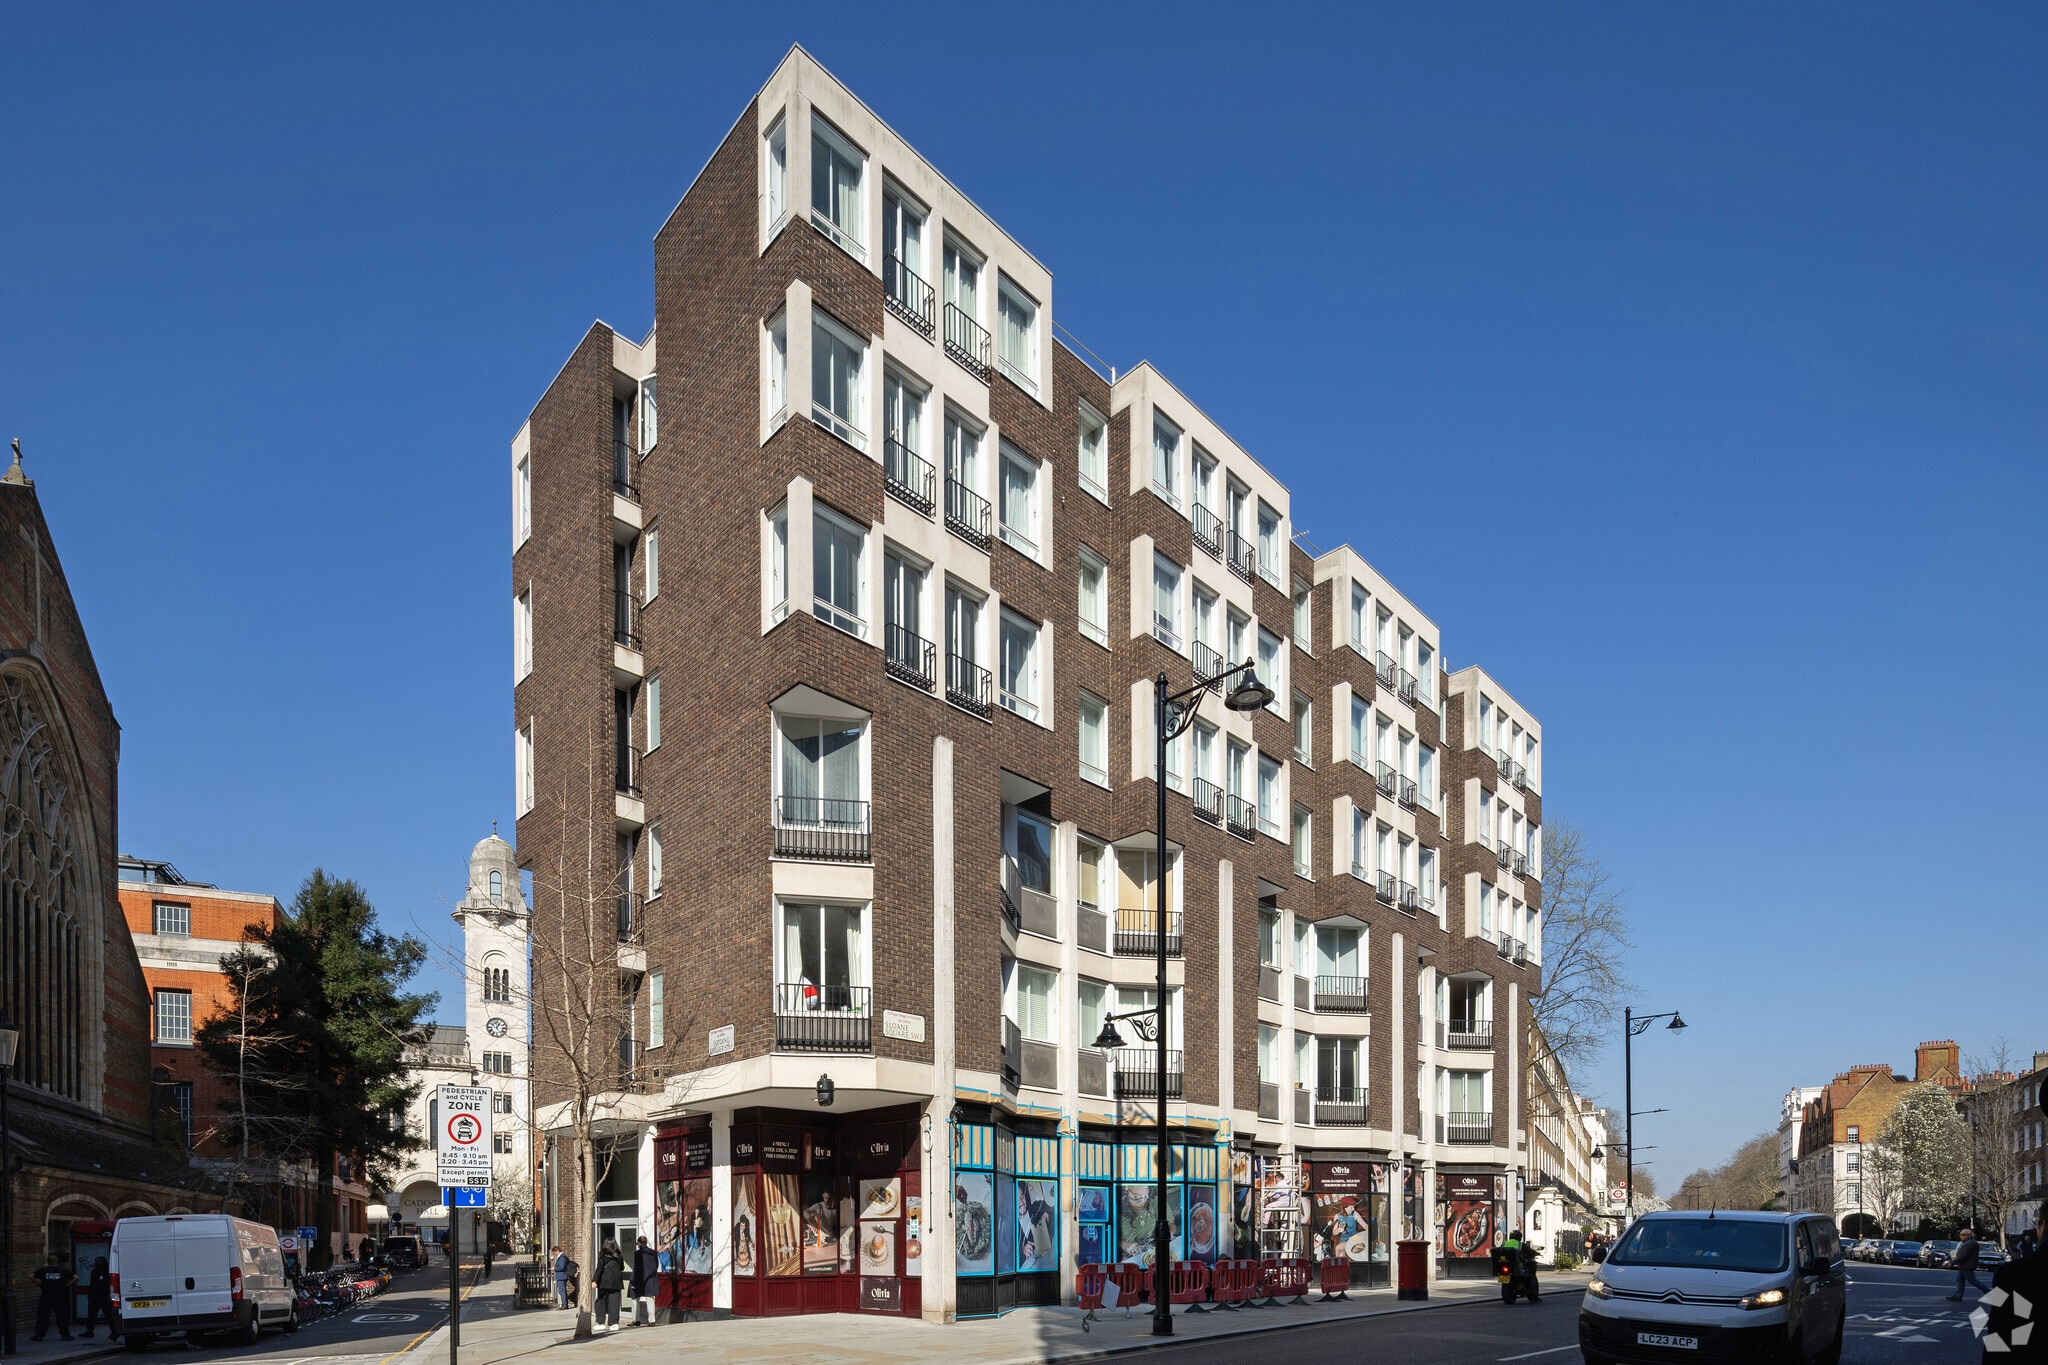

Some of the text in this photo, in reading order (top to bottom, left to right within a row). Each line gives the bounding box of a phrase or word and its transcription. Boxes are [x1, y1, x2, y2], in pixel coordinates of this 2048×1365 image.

[885, 1021, 909, 1031] SLOANE
[885, 1029, 909, 1039] SQUARE
[441, 1087, 487, 1095] PEDESTRIAN
[448, 1101, 481, 1111] ZONE
[1331, 1166, 1350, 1174] Olivia
[1462, 1177, 1478, 1185] Olivia
[416, 1208, 438, 1216] HALL
[871, 1287, 890, 1298] Olivia
[1642, 1334, 1693, 1347] LC23 ACP
